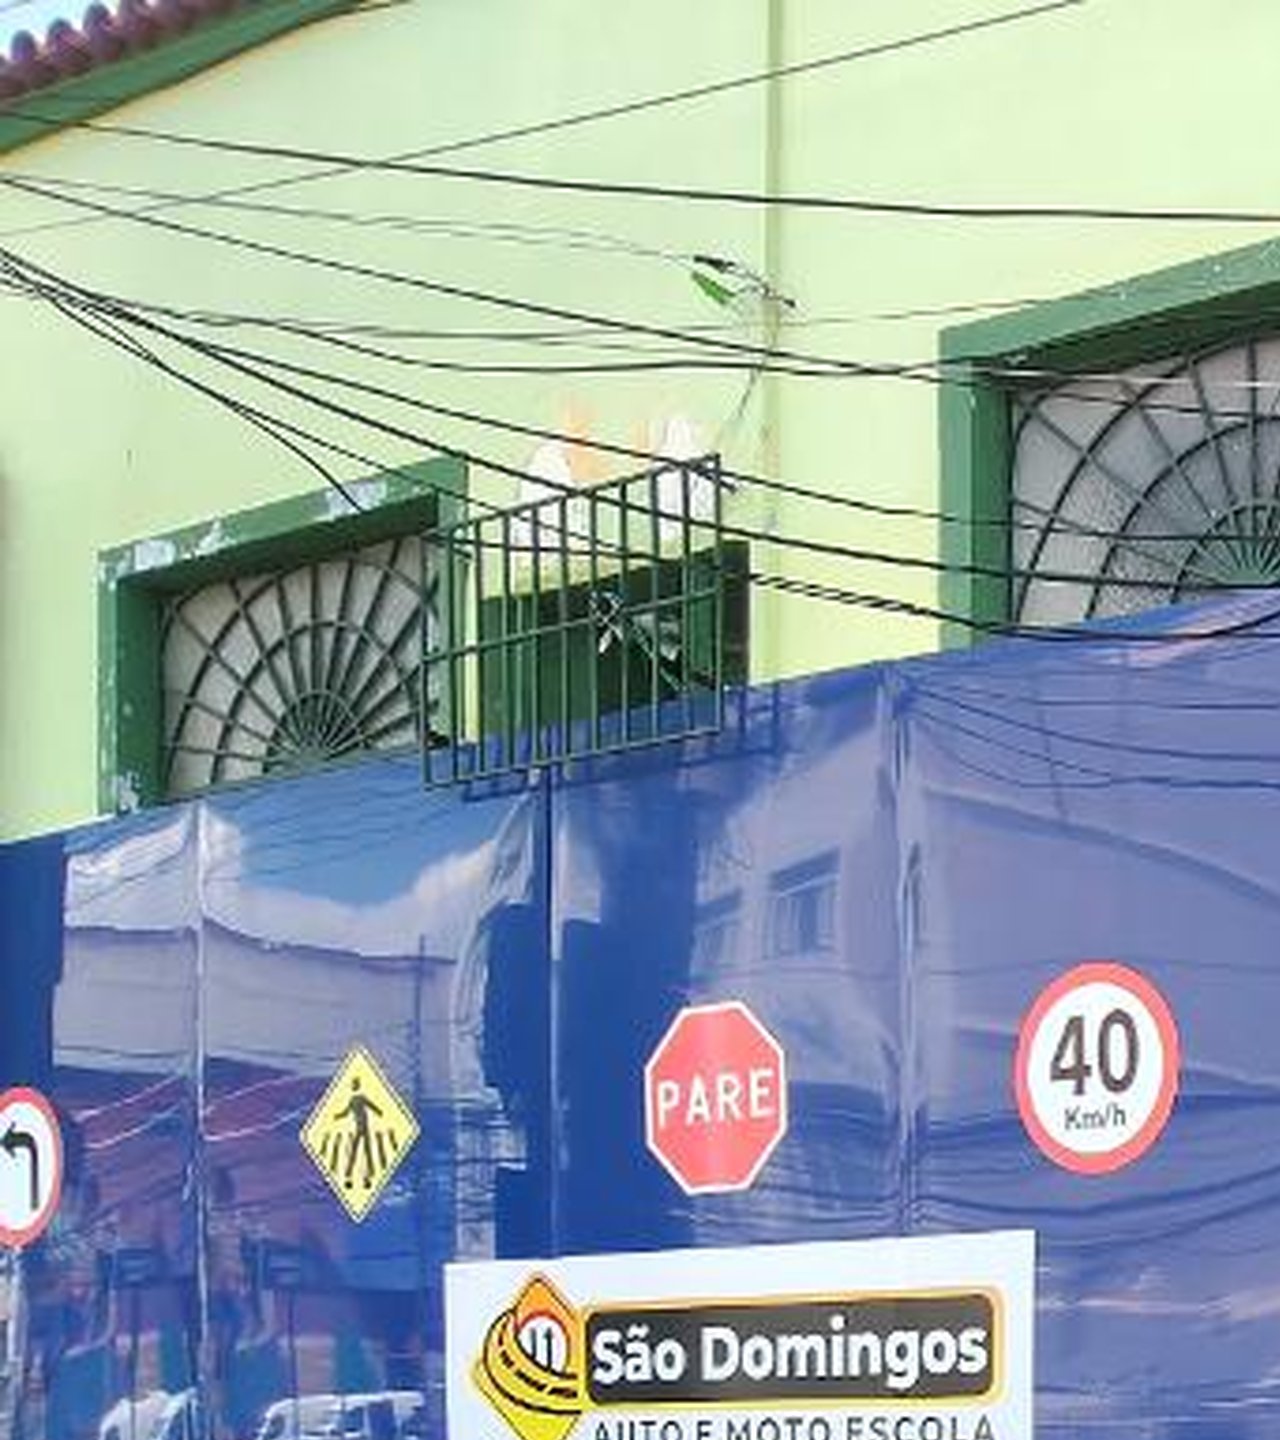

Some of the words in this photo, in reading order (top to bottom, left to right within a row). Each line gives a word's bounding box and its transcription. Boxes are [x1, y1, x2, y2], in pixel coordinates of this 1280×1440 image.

[1050, 1008, 1140, 1096] 40
[657, 1067, 775, 1130] PARE
[1065, 1102, 1127, 1132] Km/h
[592, 1323, 688, 1386] São
[701, 1313, 989, 1390] Domingos
